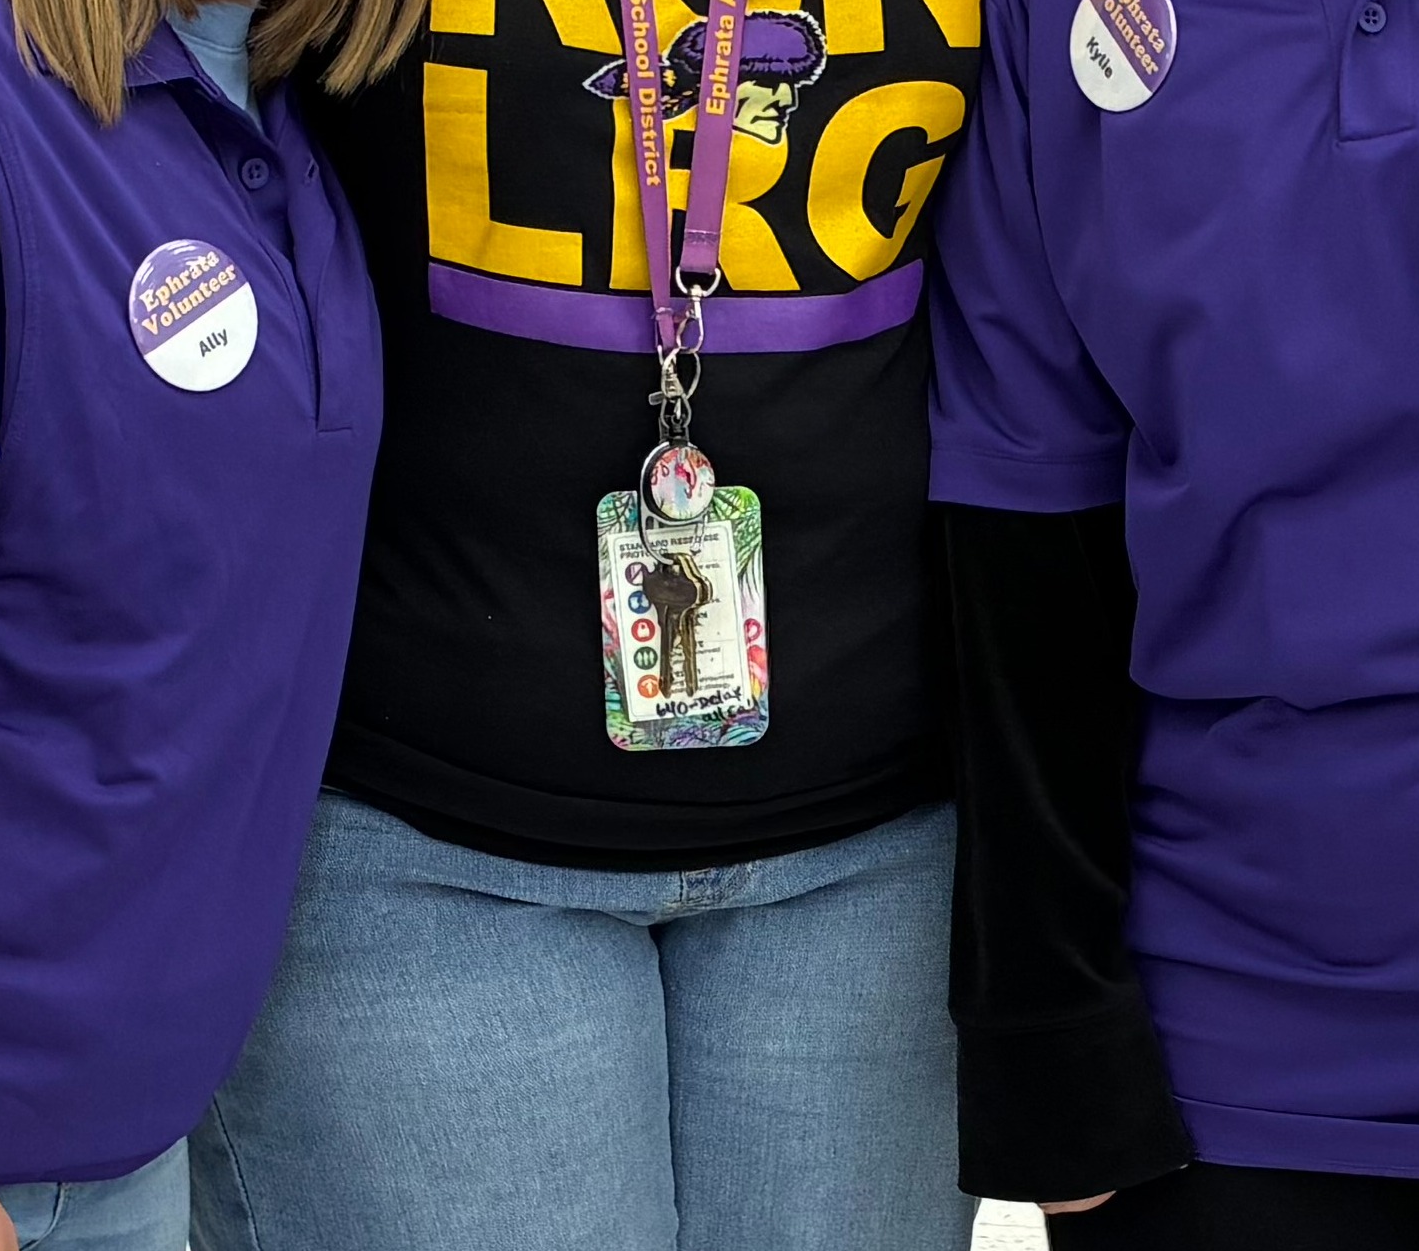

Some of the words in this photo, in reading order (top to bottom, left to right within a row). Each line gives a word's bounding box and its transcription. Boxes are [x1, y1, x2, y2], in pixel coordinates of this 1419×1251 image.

[706, 15, 735, 115] Ephrata
[1086, 36, 1113, 79] Kylie
[638, 88, 662, 186] District
[423, 62, 965, 291] LRG
[139, 251, 220, 312] Ephrata
[142, 264, 237, 336] Volunteer
[199, 328, 228, 358] Ally
